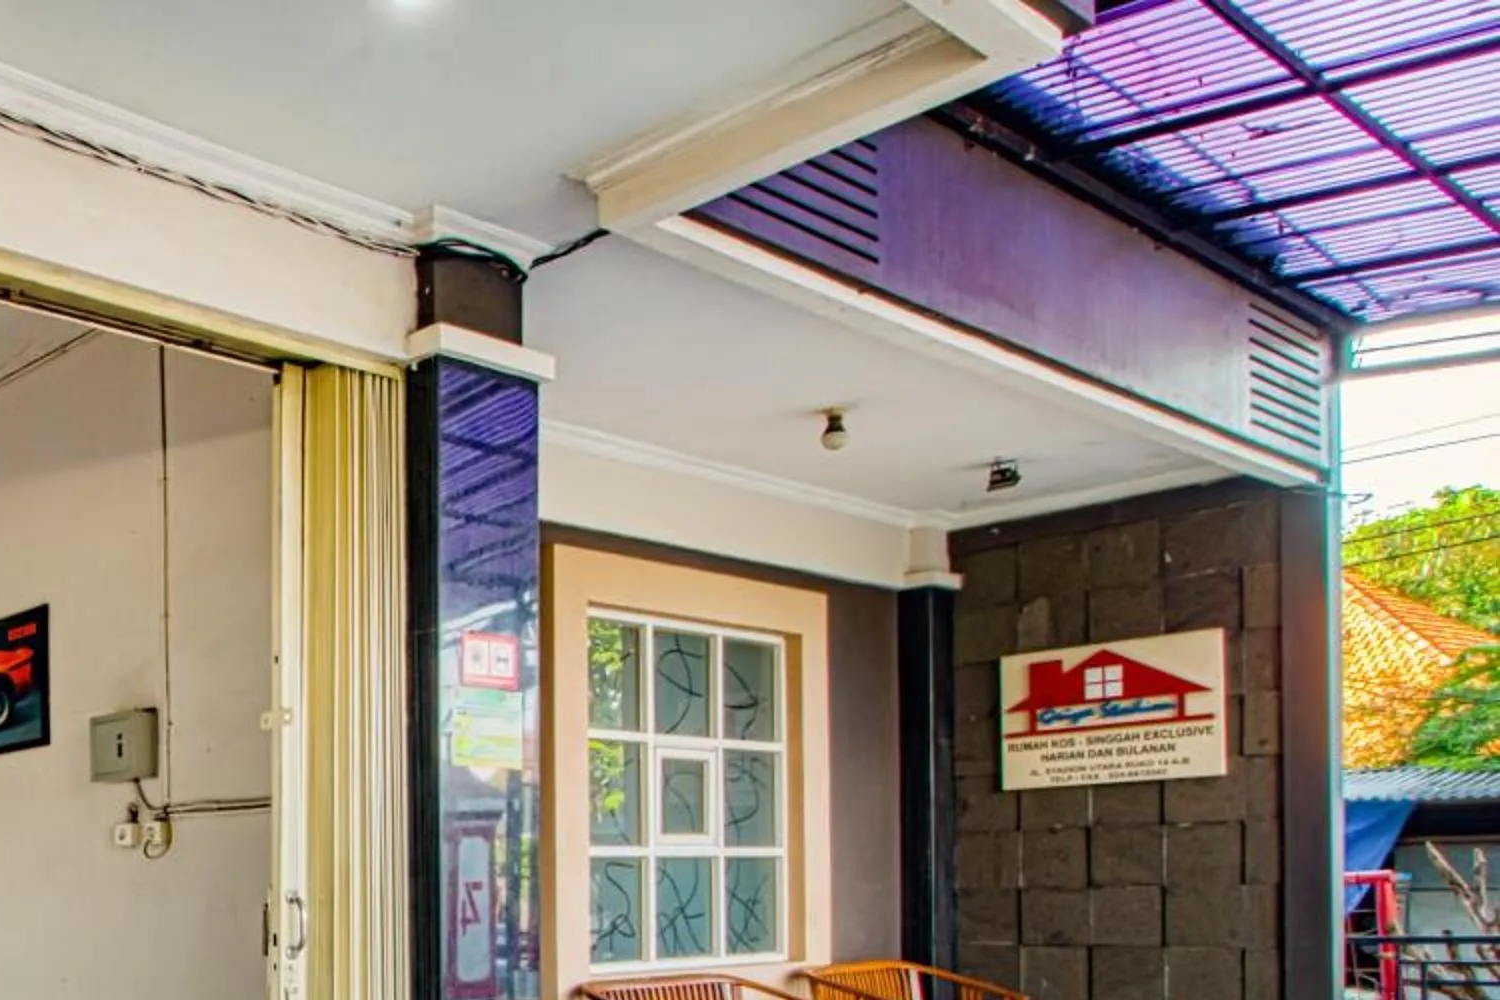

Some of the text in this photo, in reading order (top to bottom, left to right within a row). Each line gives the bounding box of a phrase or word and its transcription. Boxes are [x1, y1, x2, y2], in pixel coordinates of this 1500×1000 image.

[1008, 742, 1048, 752] RUMAH
[1051, 738, 1075, 749] KOS
[1086, 732, 1140, 745] SINGGAH
[1143, 725, 1214, 741] EXCLUSIVE
[1041, 743, 1176, 761] HARIAN DAN BULANAN
